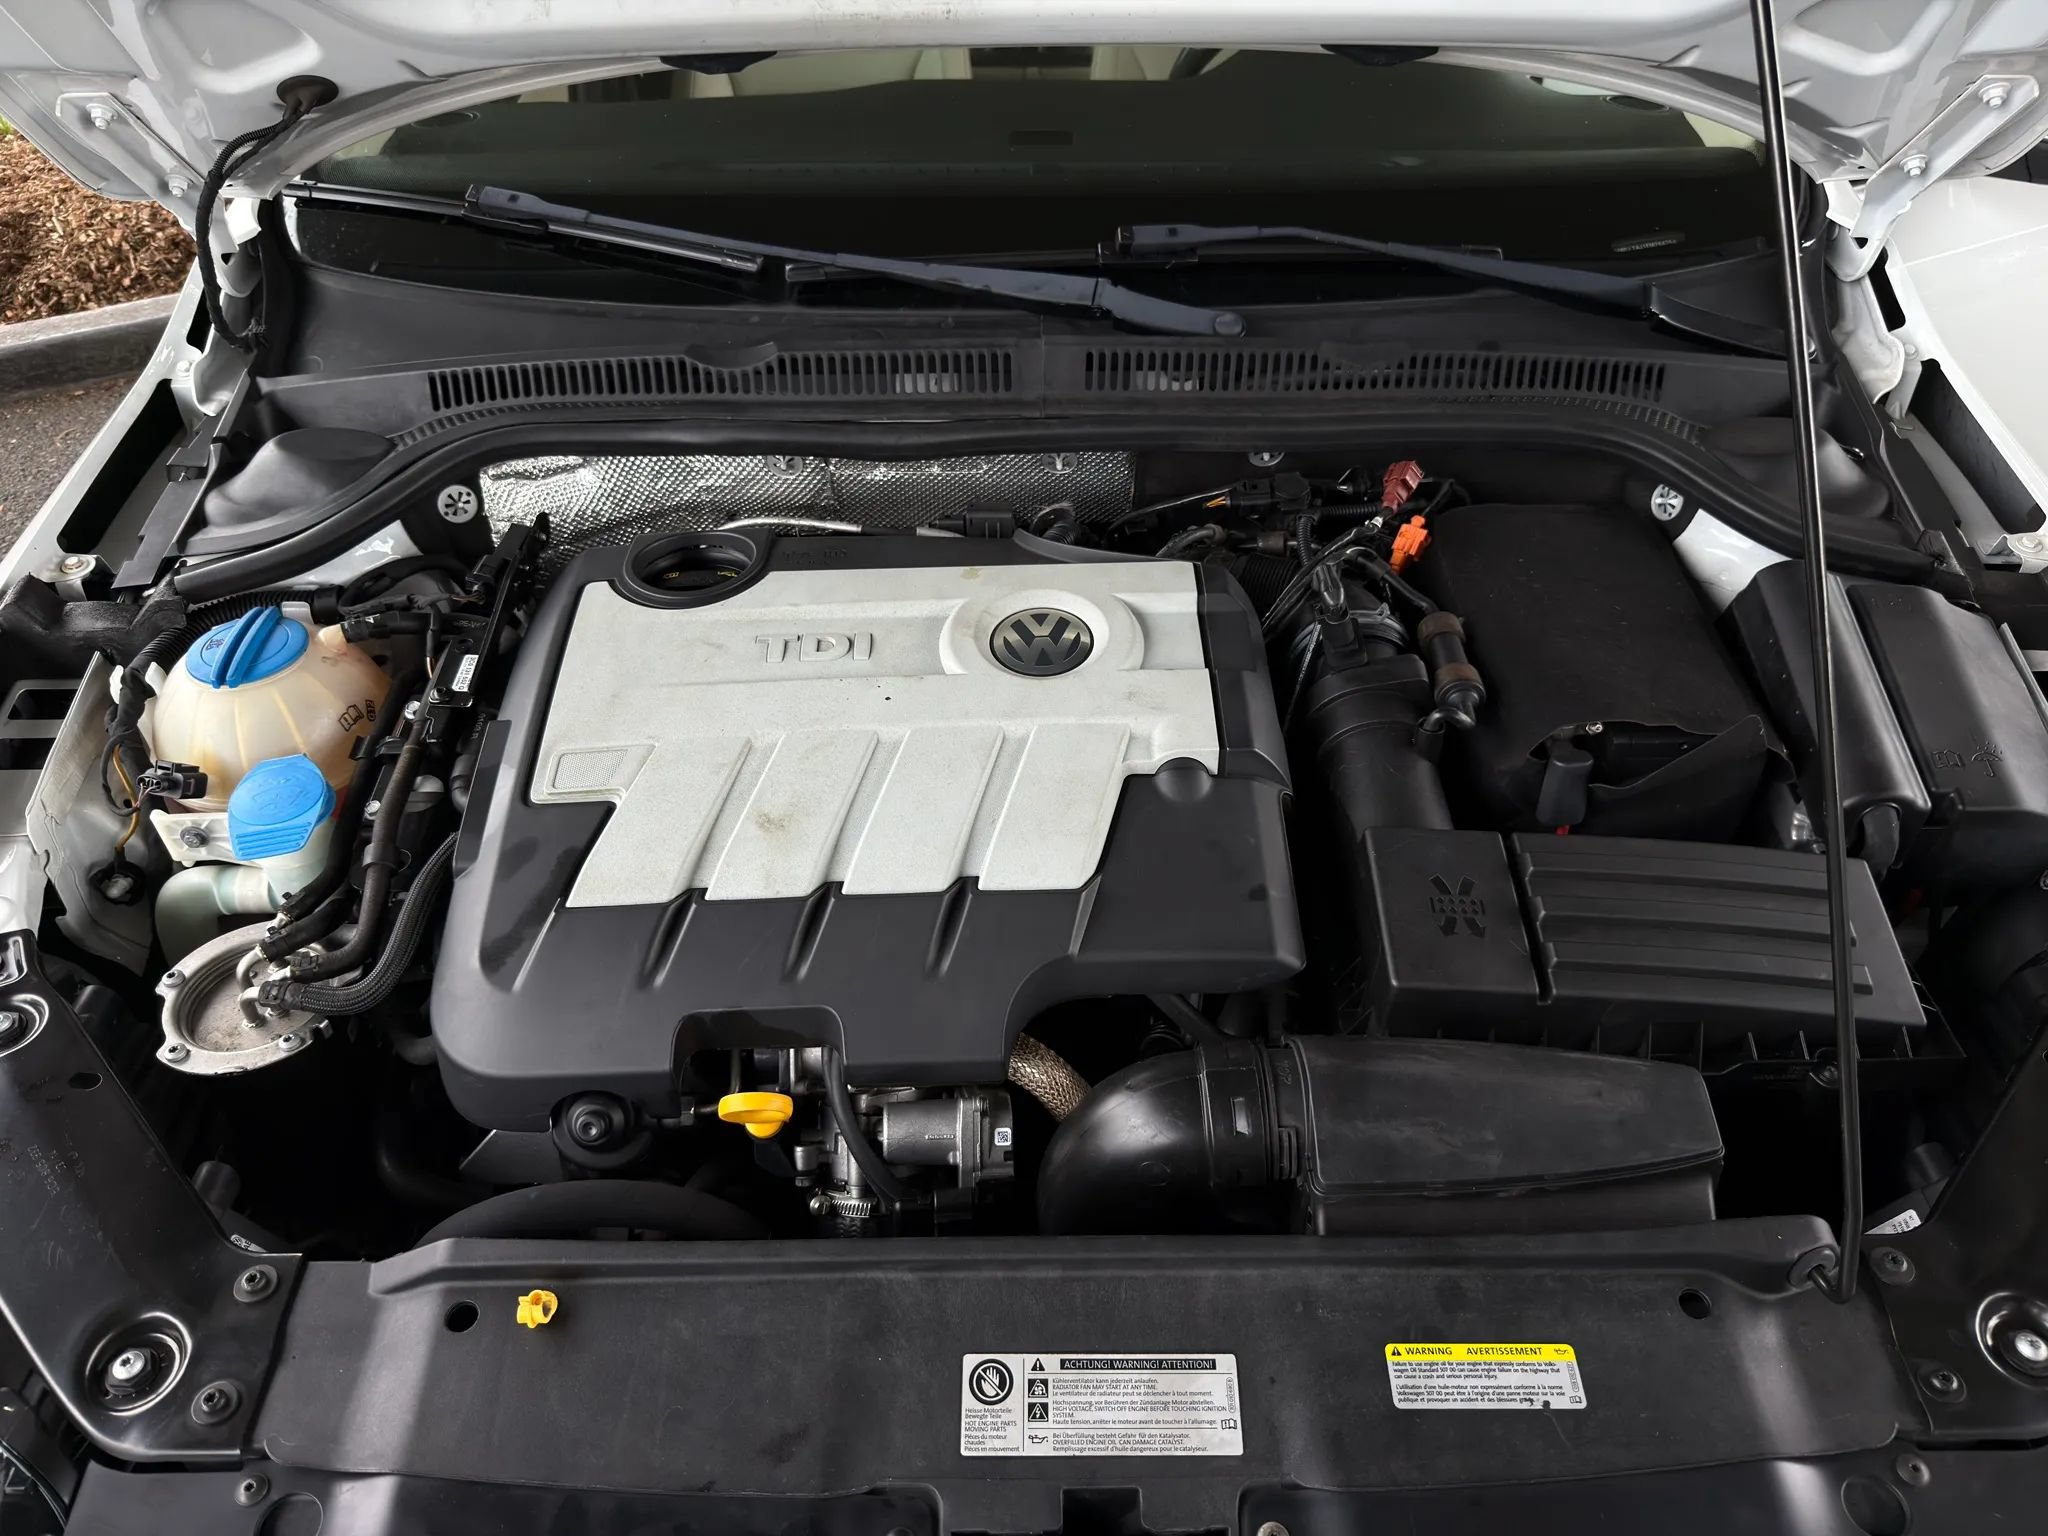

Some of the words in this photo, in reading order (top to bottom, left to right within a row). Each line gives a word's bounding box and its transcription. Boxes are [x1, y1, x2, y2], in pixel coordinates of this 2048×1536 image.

[755, 631, 873, 664] TDI
[1405, 1347, 1452, 1356] WARNING
[1466, 1347, 1542, 1356] AVERTISSEMENT
[1064, 1360, 1111, 1369] ACHTUNG!
[1113, 1360, 1159, 1369] WARNING!
[1161, 1360, 1213, 1369] ATTENTION!
